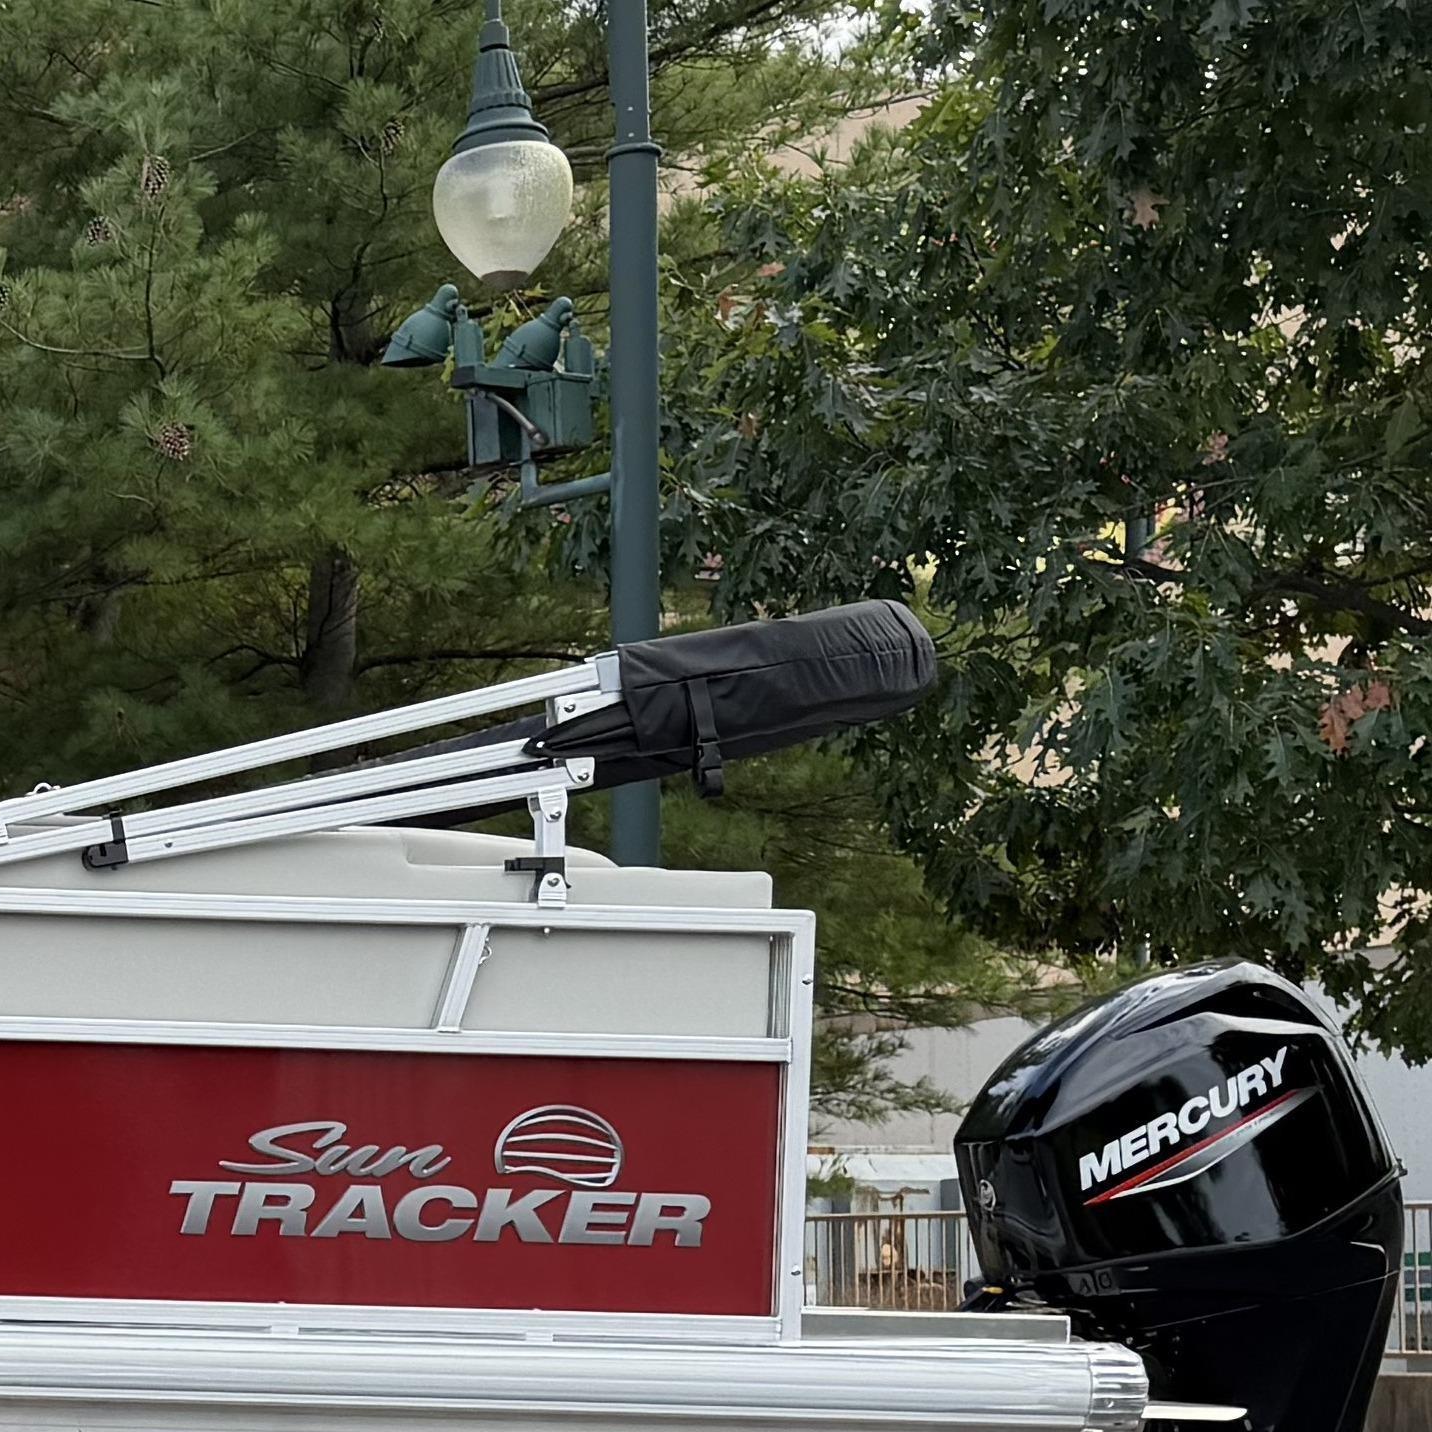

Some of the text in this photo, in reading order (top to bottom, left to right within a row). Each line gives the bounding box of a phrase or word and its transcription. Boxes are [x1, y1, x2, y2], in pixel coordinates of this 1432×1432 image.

[218, 1120, 452, 1178] Sun
[1079, 1046, 1289, 1191] MERCURY
[168, 1180, 712, 1247] TRACKER
